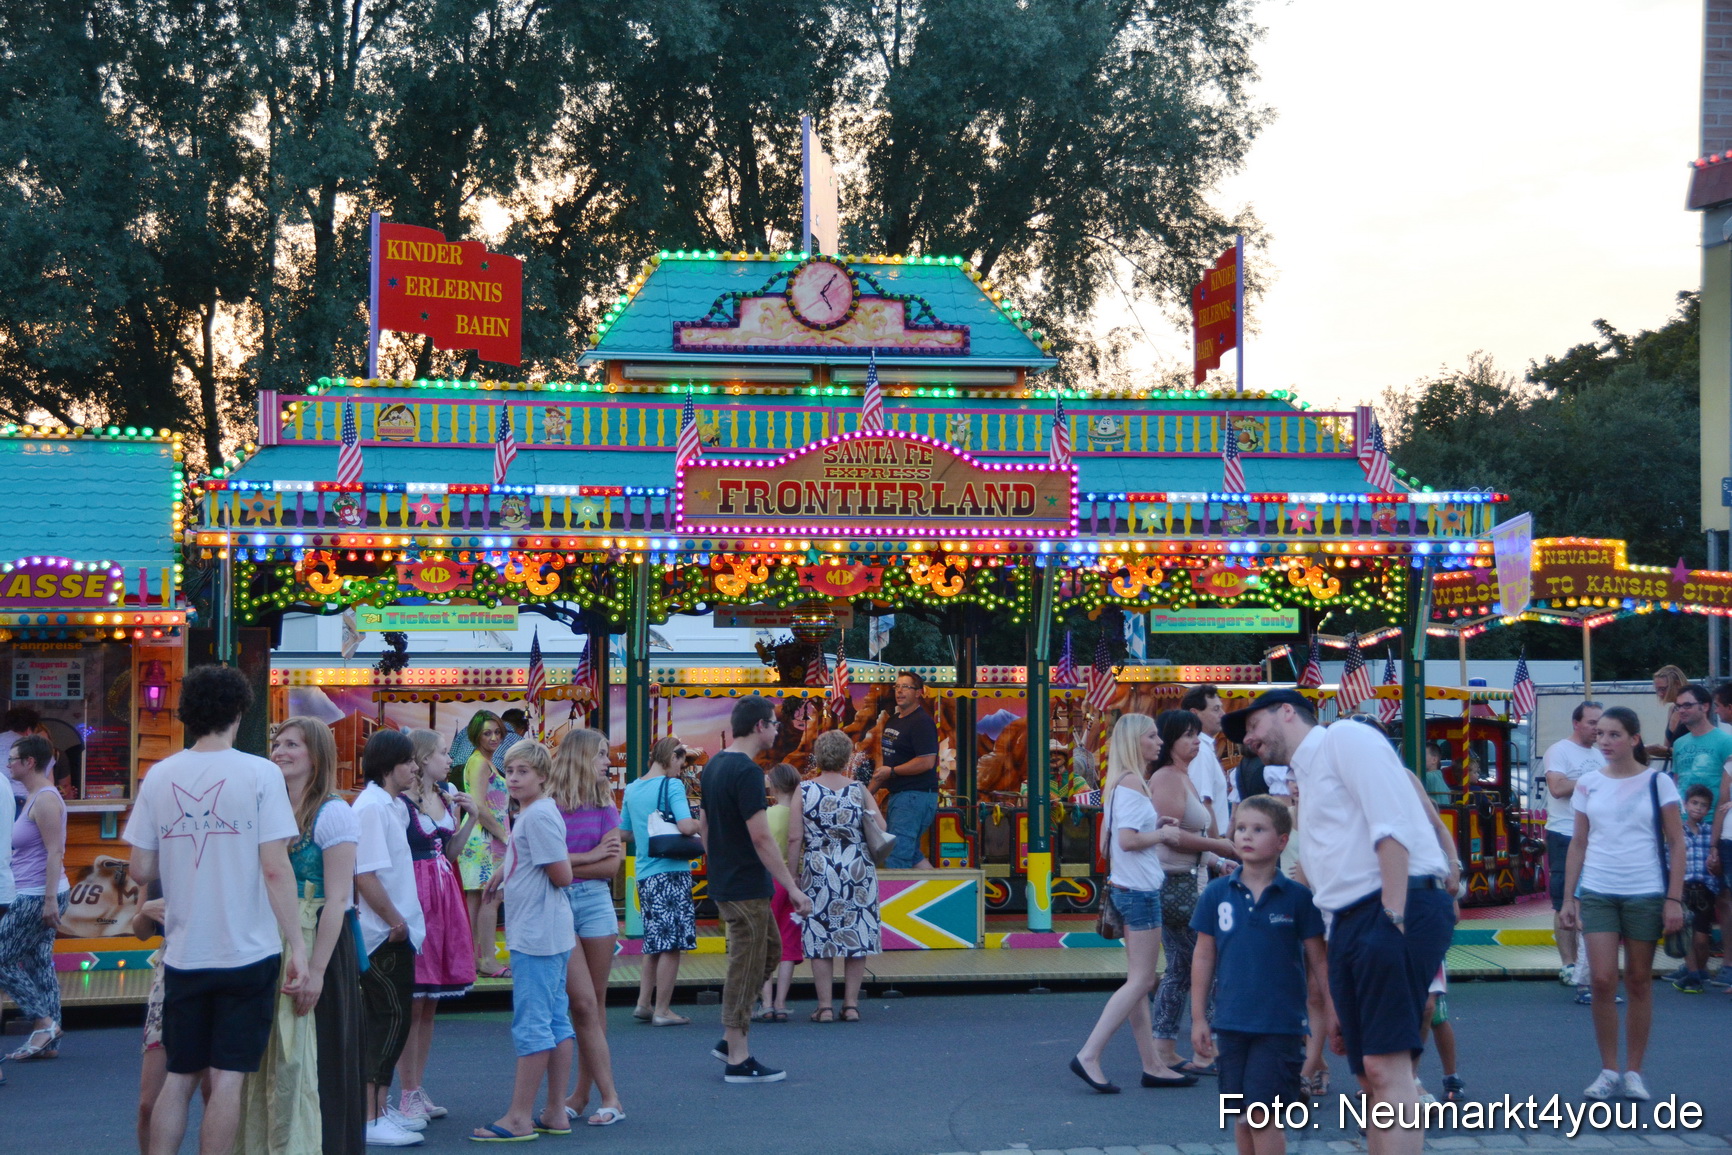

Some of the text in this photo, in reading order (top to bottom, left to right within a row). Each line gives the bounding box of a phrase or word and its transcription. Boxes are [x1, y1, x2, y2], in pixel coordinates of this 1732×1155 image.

[386, 239, 463, 265] KINDER
[405, 275, 503, 303] ERLEBNIS
[1210, 264, 1236, 292] KINDER
[456, 314, 511, 338] BAHN
[1198, 300, 1231, 329] ERLEBNIS
[1196, 338, 1214, 361] BAHN
[823, 440, 935, 466] SANTA FE
[823, 467, 932, 480] EXPRESS
[717, 478, 1037, 518] FRONTIERLAND
[1543, 549, 1611, 565] NEVADA
[0, 573, 108, 598] ASSE
[420, 566, 451, 584] MB
[825, 569, 855, 586] MB
[1546, 575, 1574, 595] TO
[1586, 576, 1668, 599] KANSAS
[1682, 583, 1732, 603] CITY
[386, 611, 515, 624] Ticket office
[1155, 615, 1295, 628] Passangers only
[70, 883, 104, 905] US
[96, 917, 118, 925] Chicago
[1217, 901, 1234, 932] 8
